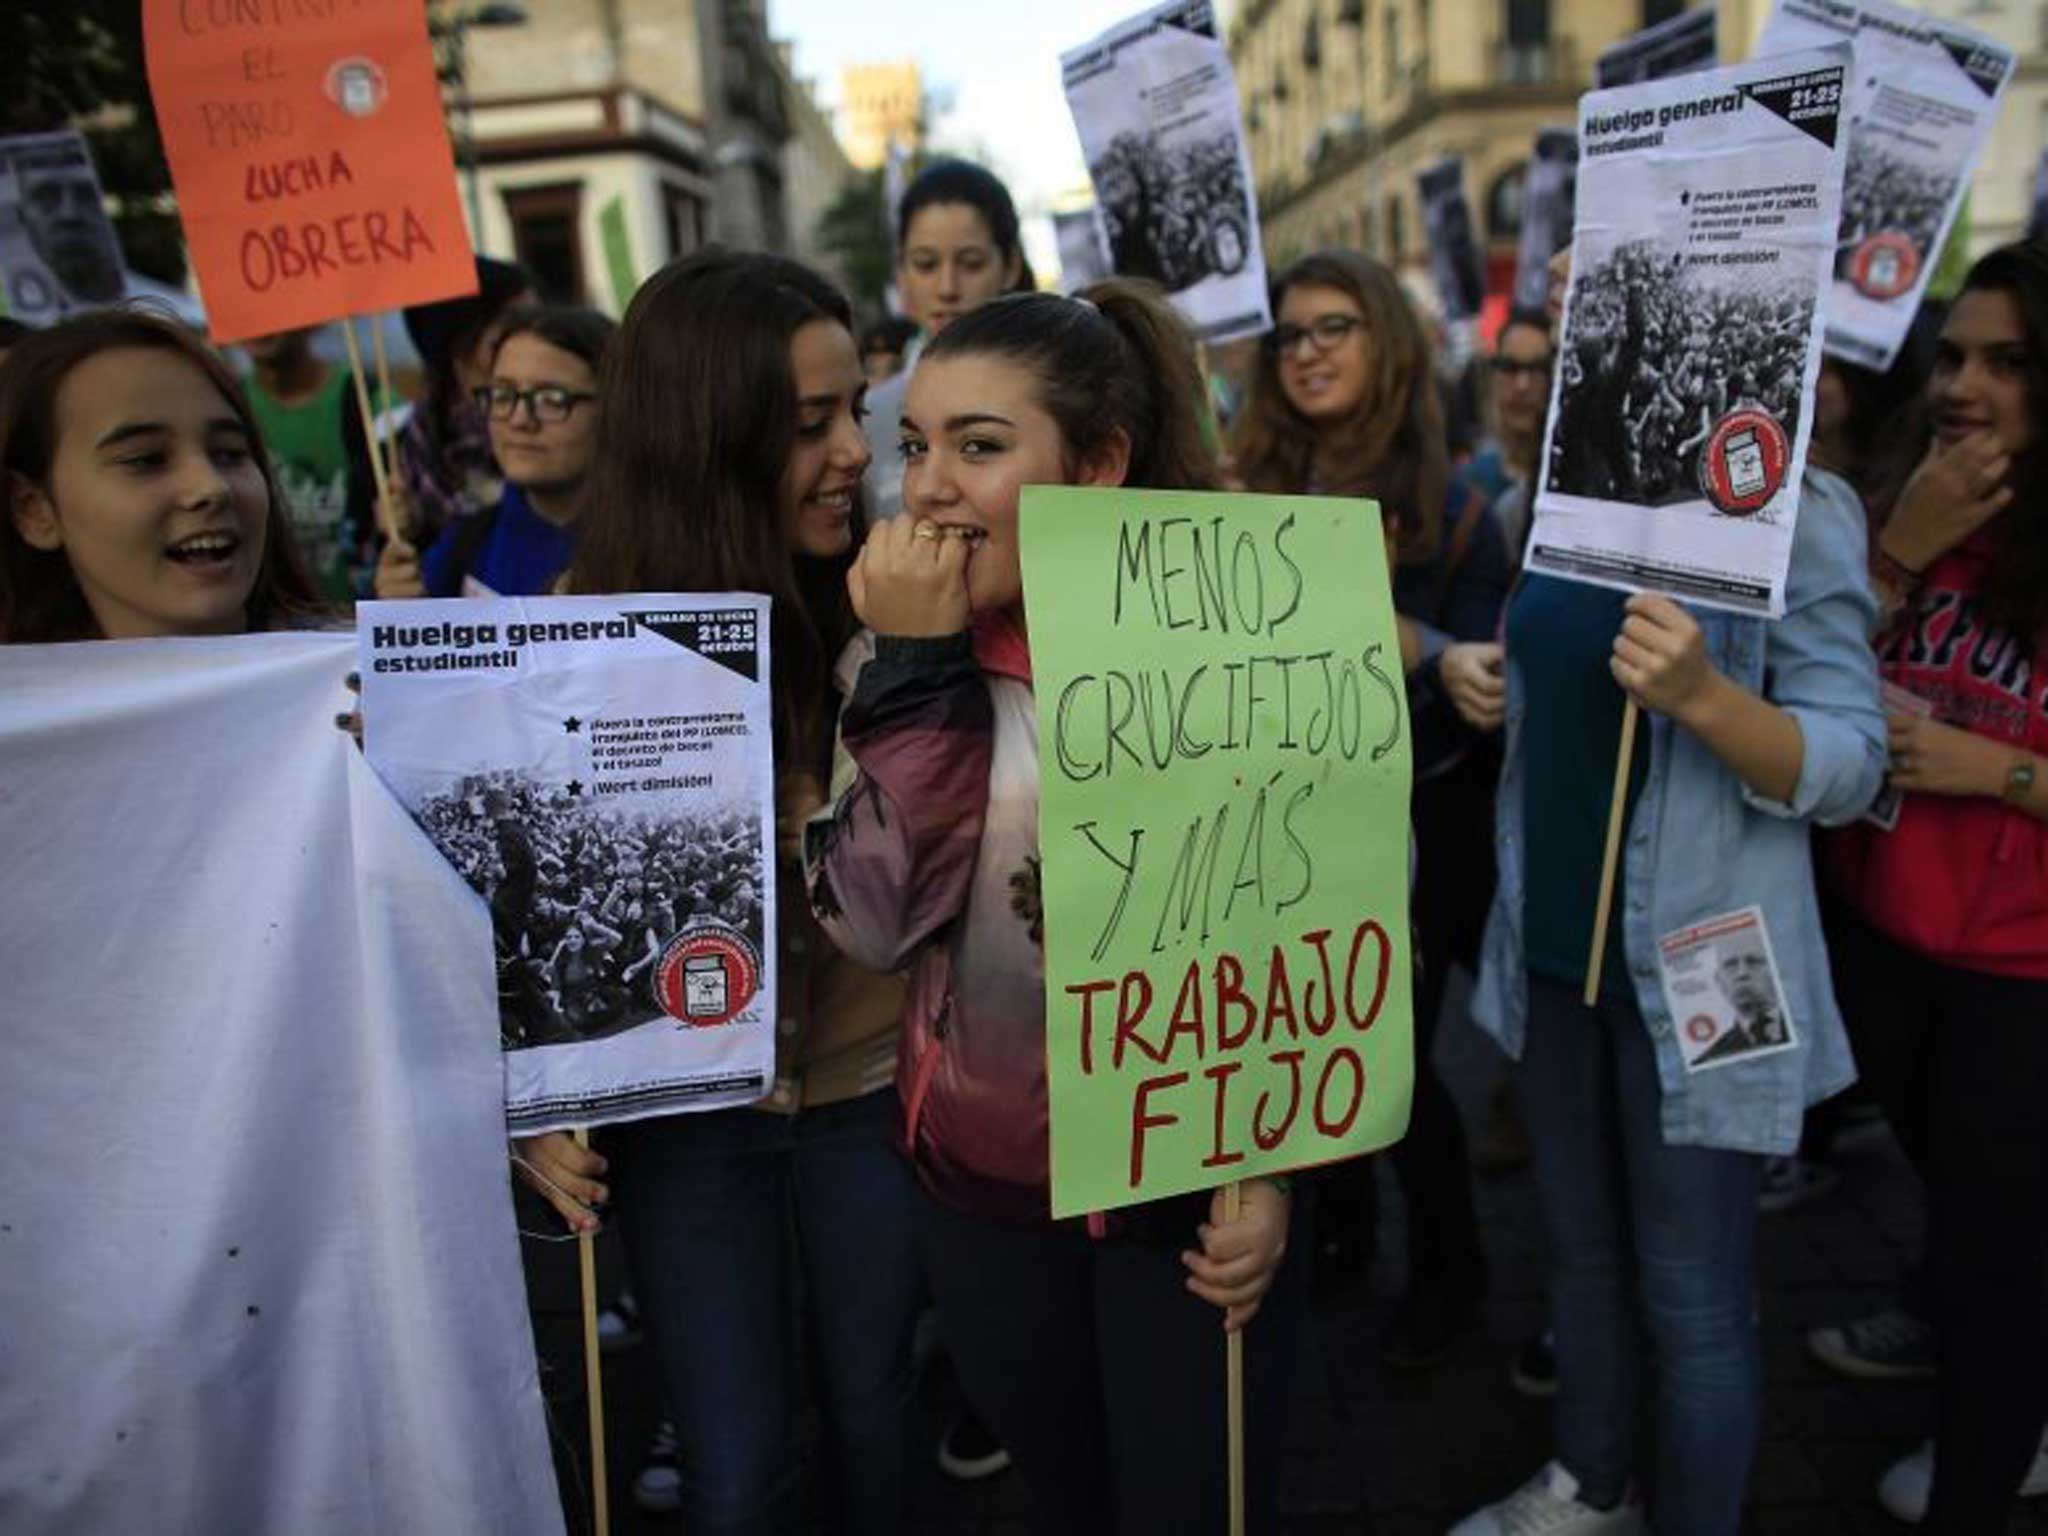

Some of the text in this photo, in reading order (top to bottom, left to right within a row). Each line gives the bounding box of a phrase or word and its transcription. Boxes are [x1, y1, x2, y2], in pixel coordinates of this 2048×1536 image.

[179, 0, 359, 36] CONT
[241, 47, 285, 82] EL
[1585, 93, 1744, 136] Huelga general
[1790, 83, 1841, 108] 21-25
[200, 97, 294, 148] PARO
[1587, 131, 1664, 156] estudiantil
[245, 151, 352, 203] LUCHA
[240, 204, 436, 292] OBRERA
[1113, 511, 1304, 640] MENOS
[373, 617, 637, 649] Huelga general
[697, 624, 755, 641] 21-25
[699, 640, 754, 654] octubre
[373, 651, 518, 674] estudiantil
[1055, 642, 1401, 782] CRUCIFIJOS
[641, 774, 713, 791] dimisión!
[1072, 770, 1315, 963] Y MÁS
[1064, 919, 1392, 1076] TRABAJO
[1128, 1046, 1365, 1189] FIJO
